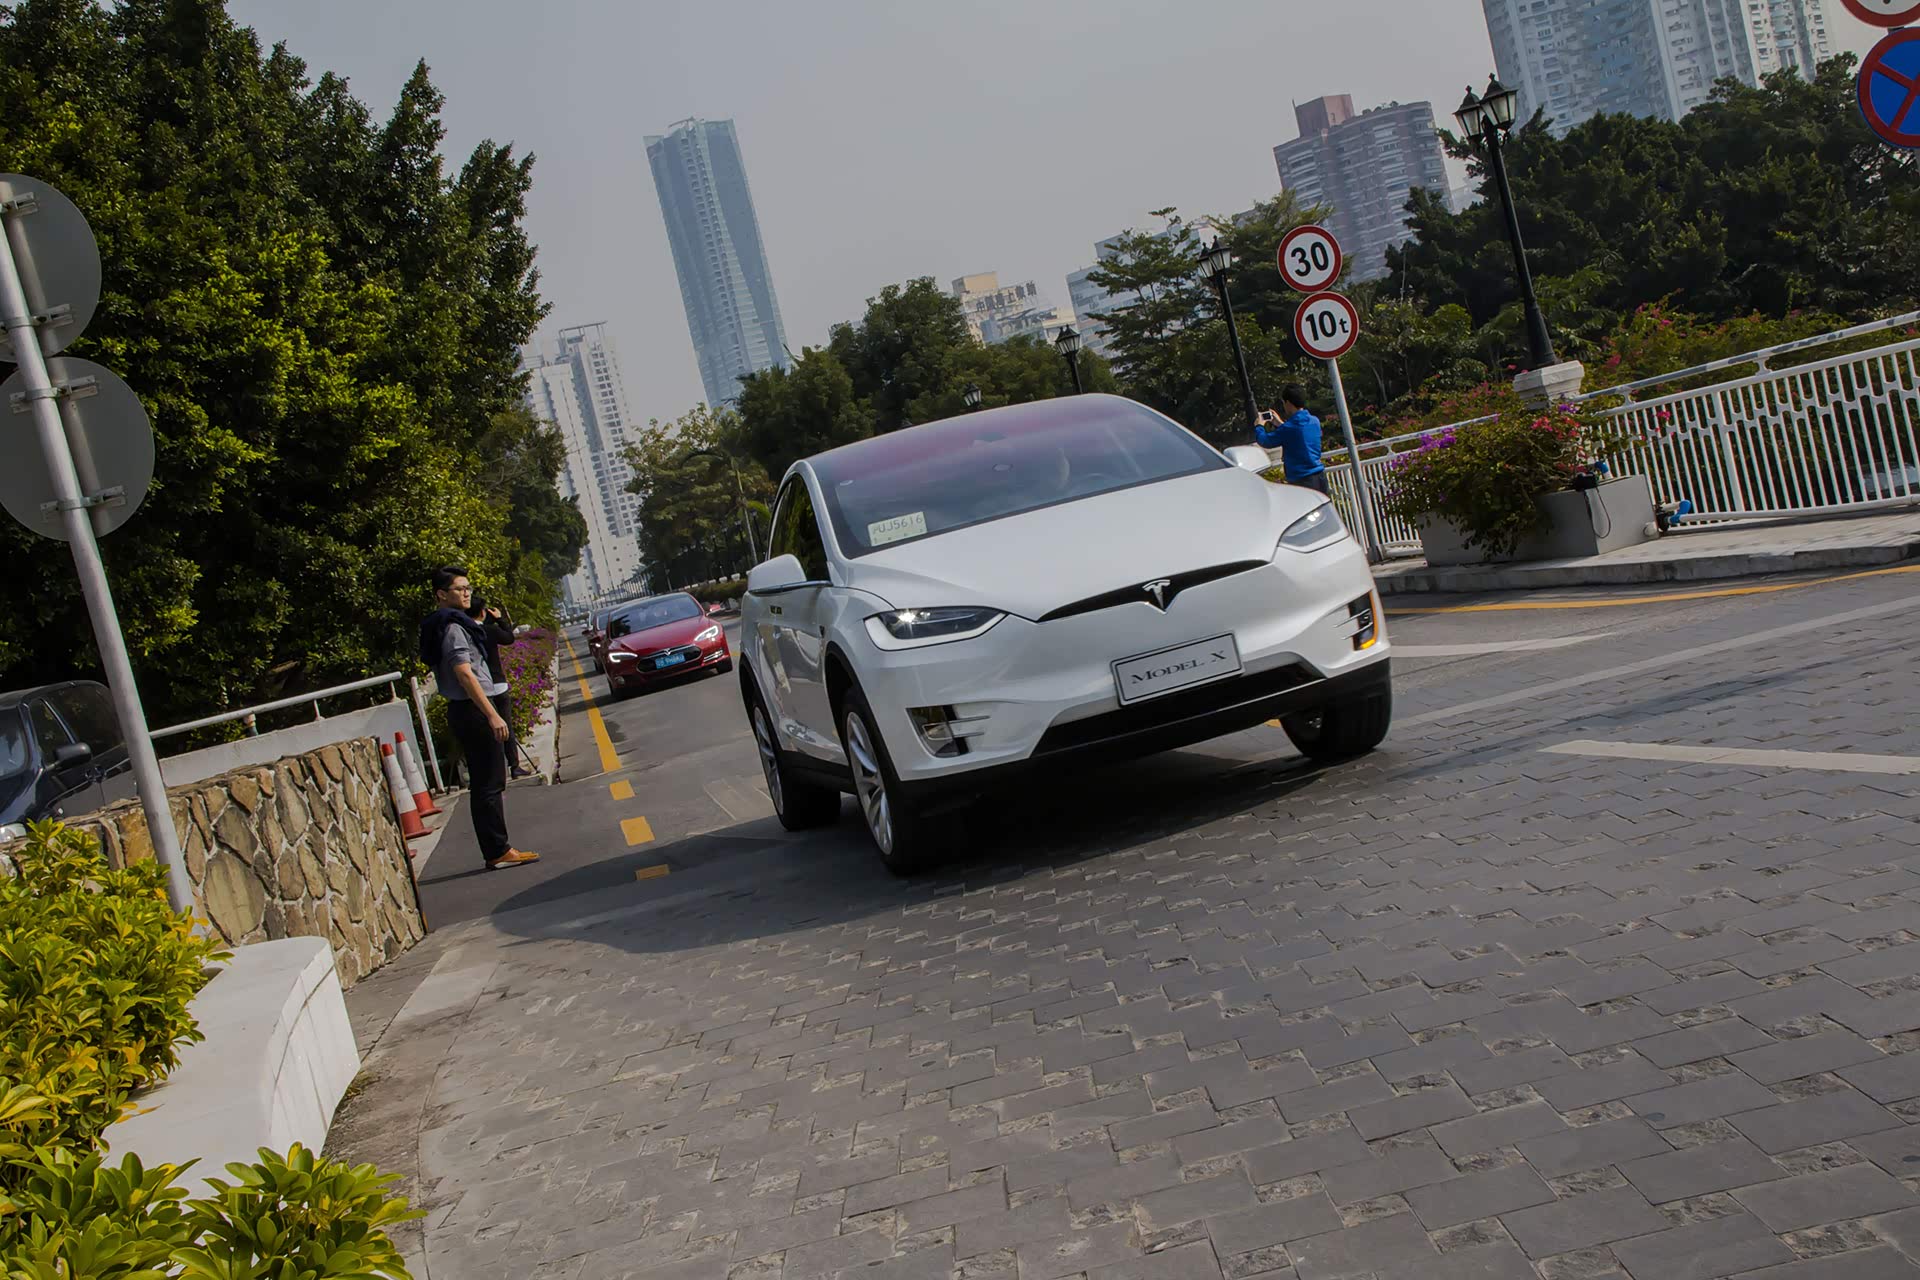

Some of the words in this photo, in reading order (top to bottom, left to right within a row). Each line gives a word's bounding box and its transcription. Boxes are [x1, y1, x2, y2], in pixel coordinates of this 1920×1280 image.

[1291, 241, 1329, 277] 30
[1305, 310, 1349, 341] 10t
[1131, 659, 1205, 685] MODEL
[1211, 650, 1227, 663] X
